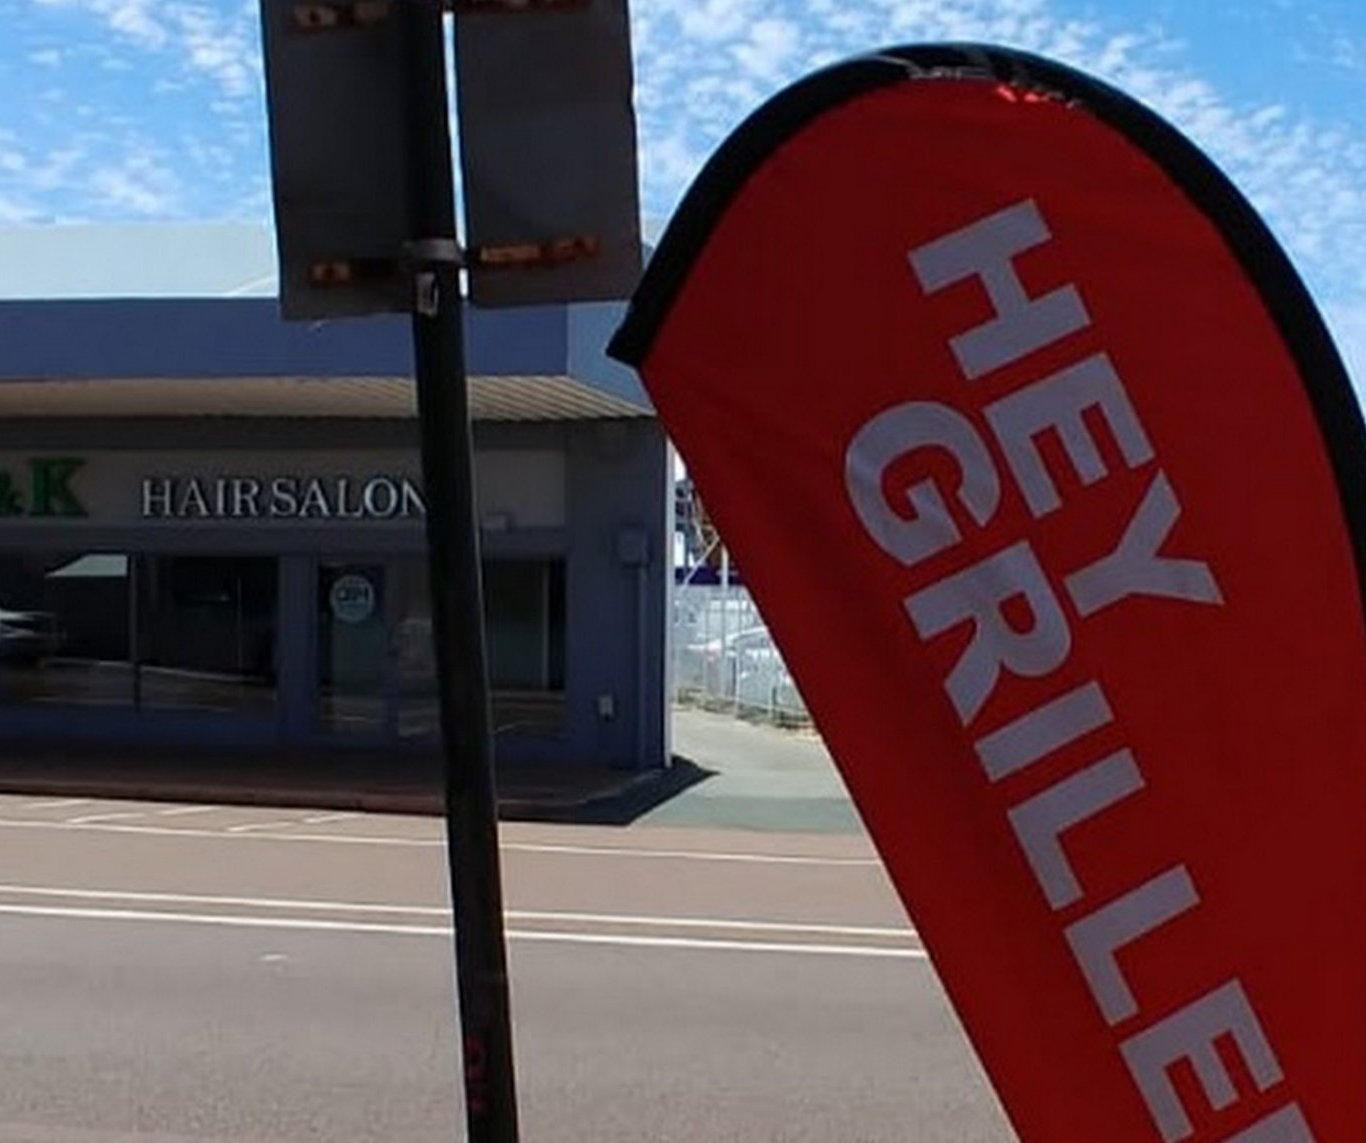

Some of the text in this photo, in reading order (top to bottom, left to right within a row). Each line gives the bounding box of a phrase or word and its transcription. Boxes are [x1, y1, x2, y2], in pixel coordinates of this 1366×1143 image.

[141, 479, 260, 517] HAIR
[269, 477, 427, 518] SALON
[908, 198, 1224, 617] HEY
